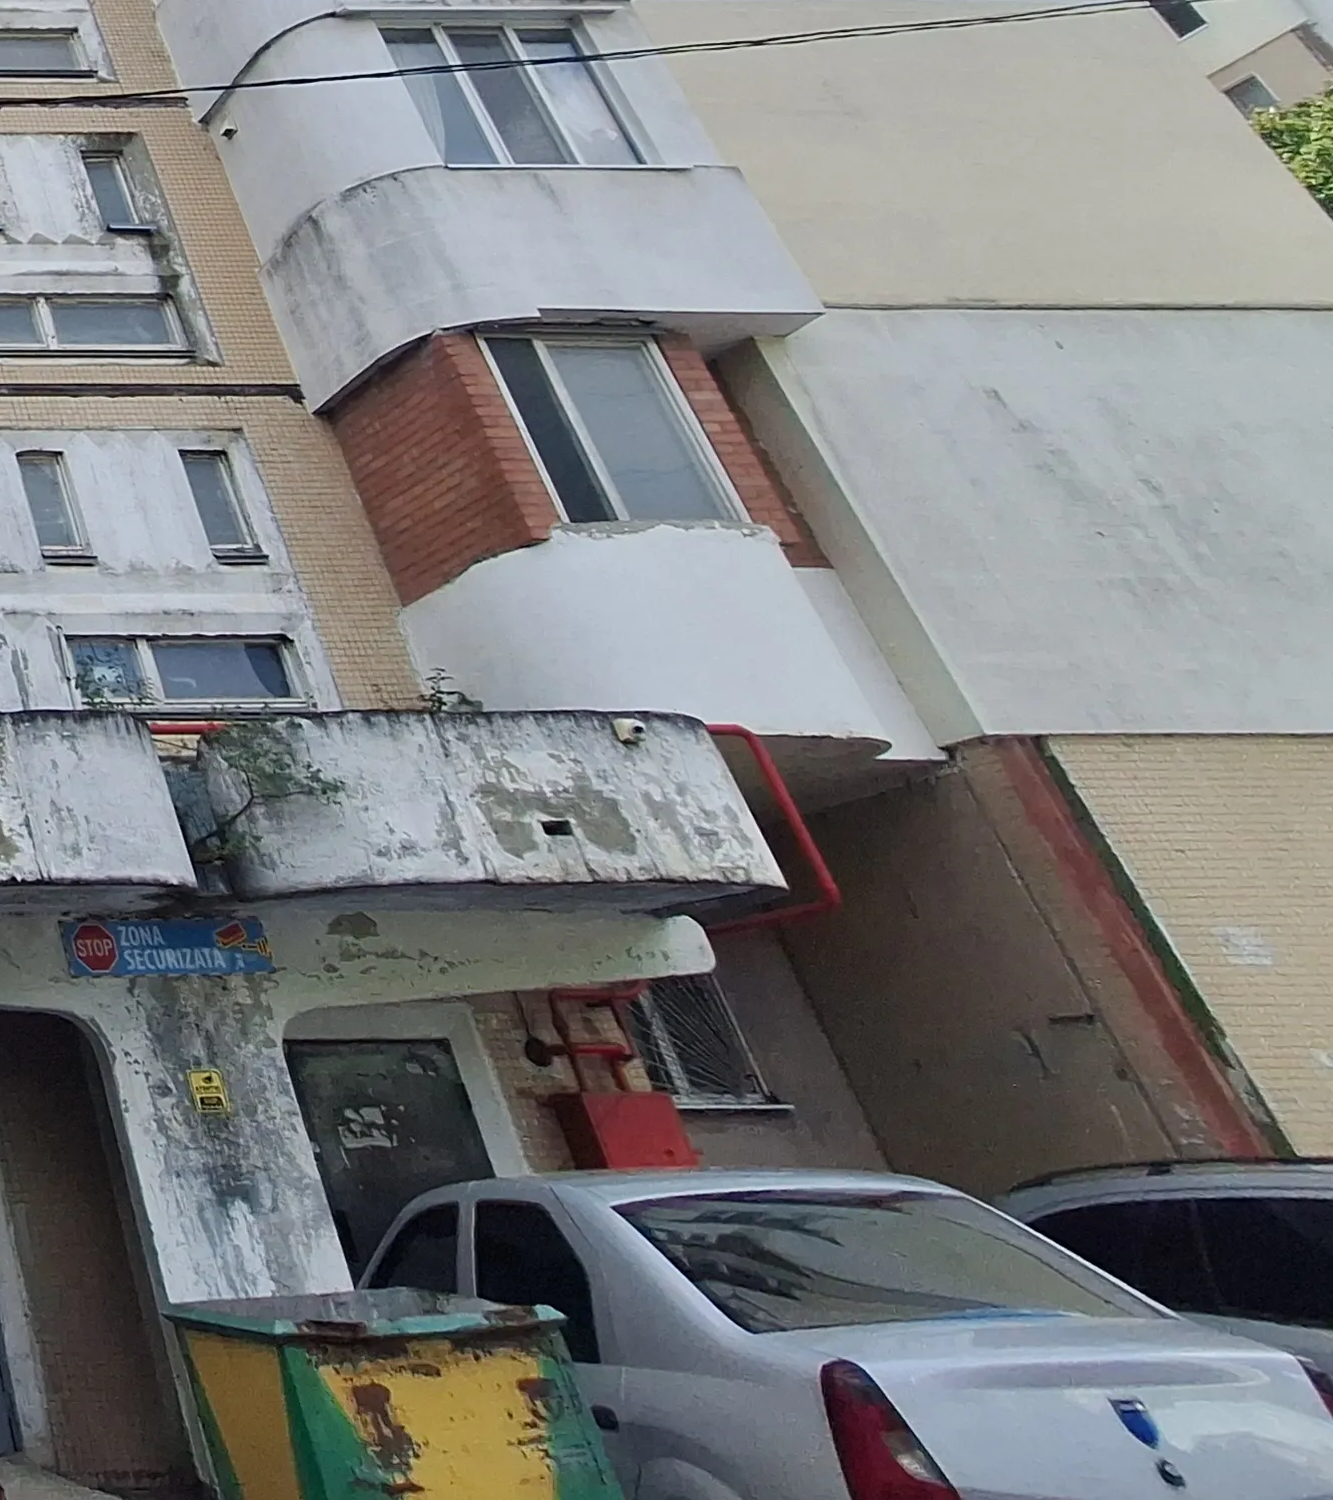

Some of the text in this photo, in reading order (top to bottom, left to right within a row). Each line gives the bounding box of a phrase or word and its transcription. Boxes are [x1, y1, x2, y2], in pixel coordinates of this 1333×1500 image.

[117, 925, 166, 946] ZONA
[76, 937, 113, 957] STOP
[123, 948, 226, 970] SECURIZATA
